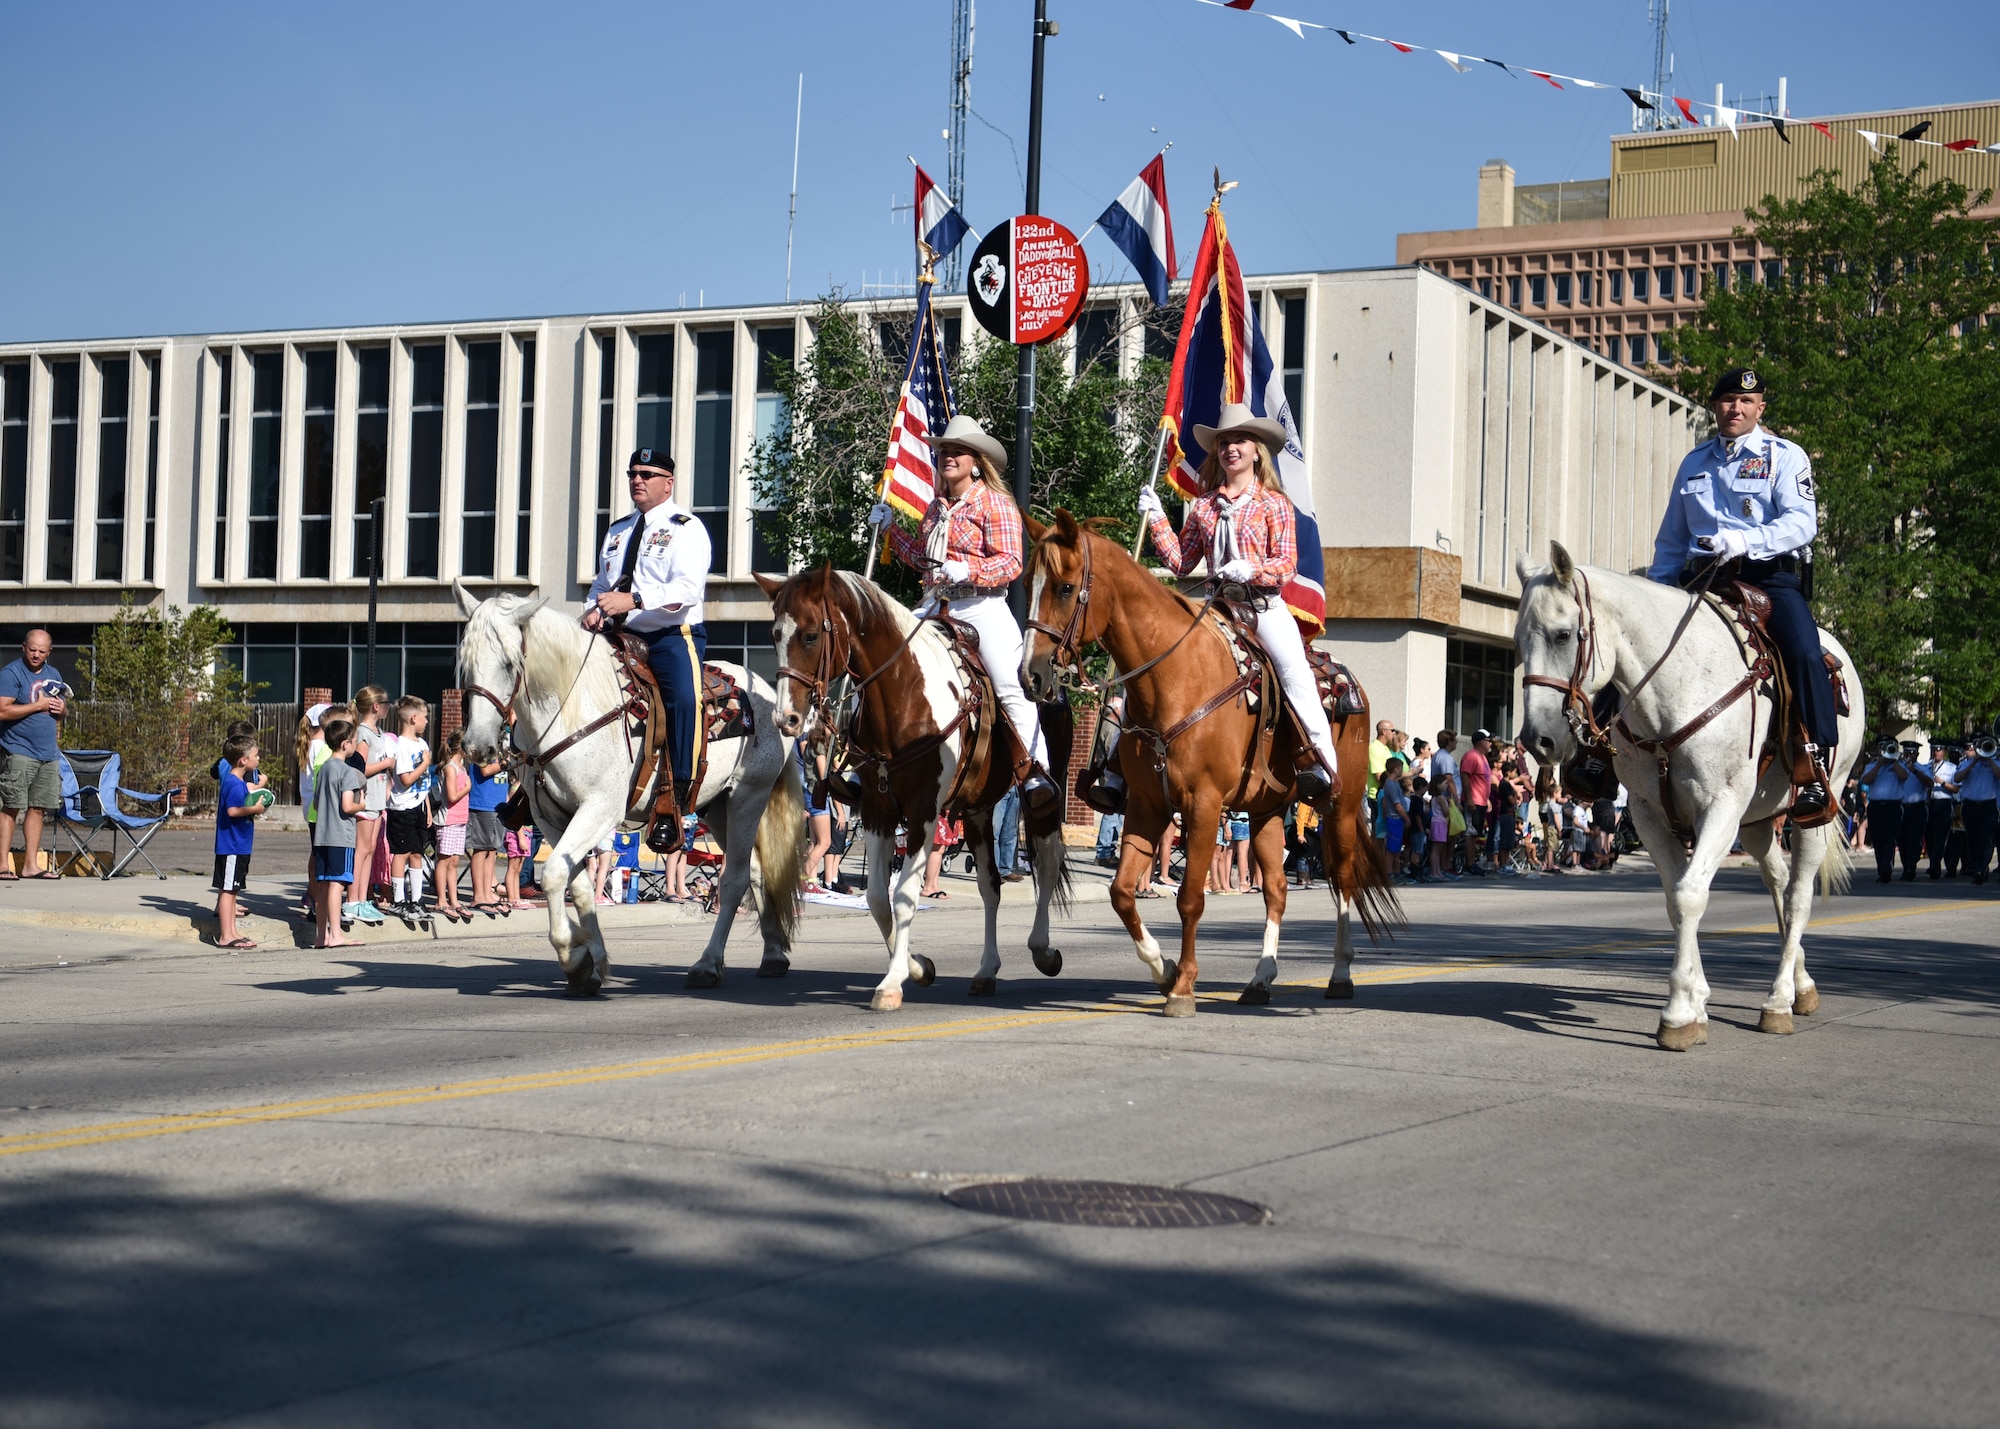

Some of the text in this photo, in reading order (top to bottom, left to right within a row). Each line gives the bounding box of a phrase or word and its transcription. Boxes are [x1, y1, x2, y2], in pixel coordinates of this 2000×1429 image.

[1016, 223, 1055, 238] 122nd
[1022, 237, 1065, 251] ANNUAL
[1018, 250, 1046, 265] DADDY
[1061, 245, 1076, 259] ALL
[1017, 264, 1076, 285] CHEYENNE
[1018, 280, 1075, 298] FRONTIER
[1032, 293, 1059, 308] DAYS
[1019, 320, 1045, 331] JULY
